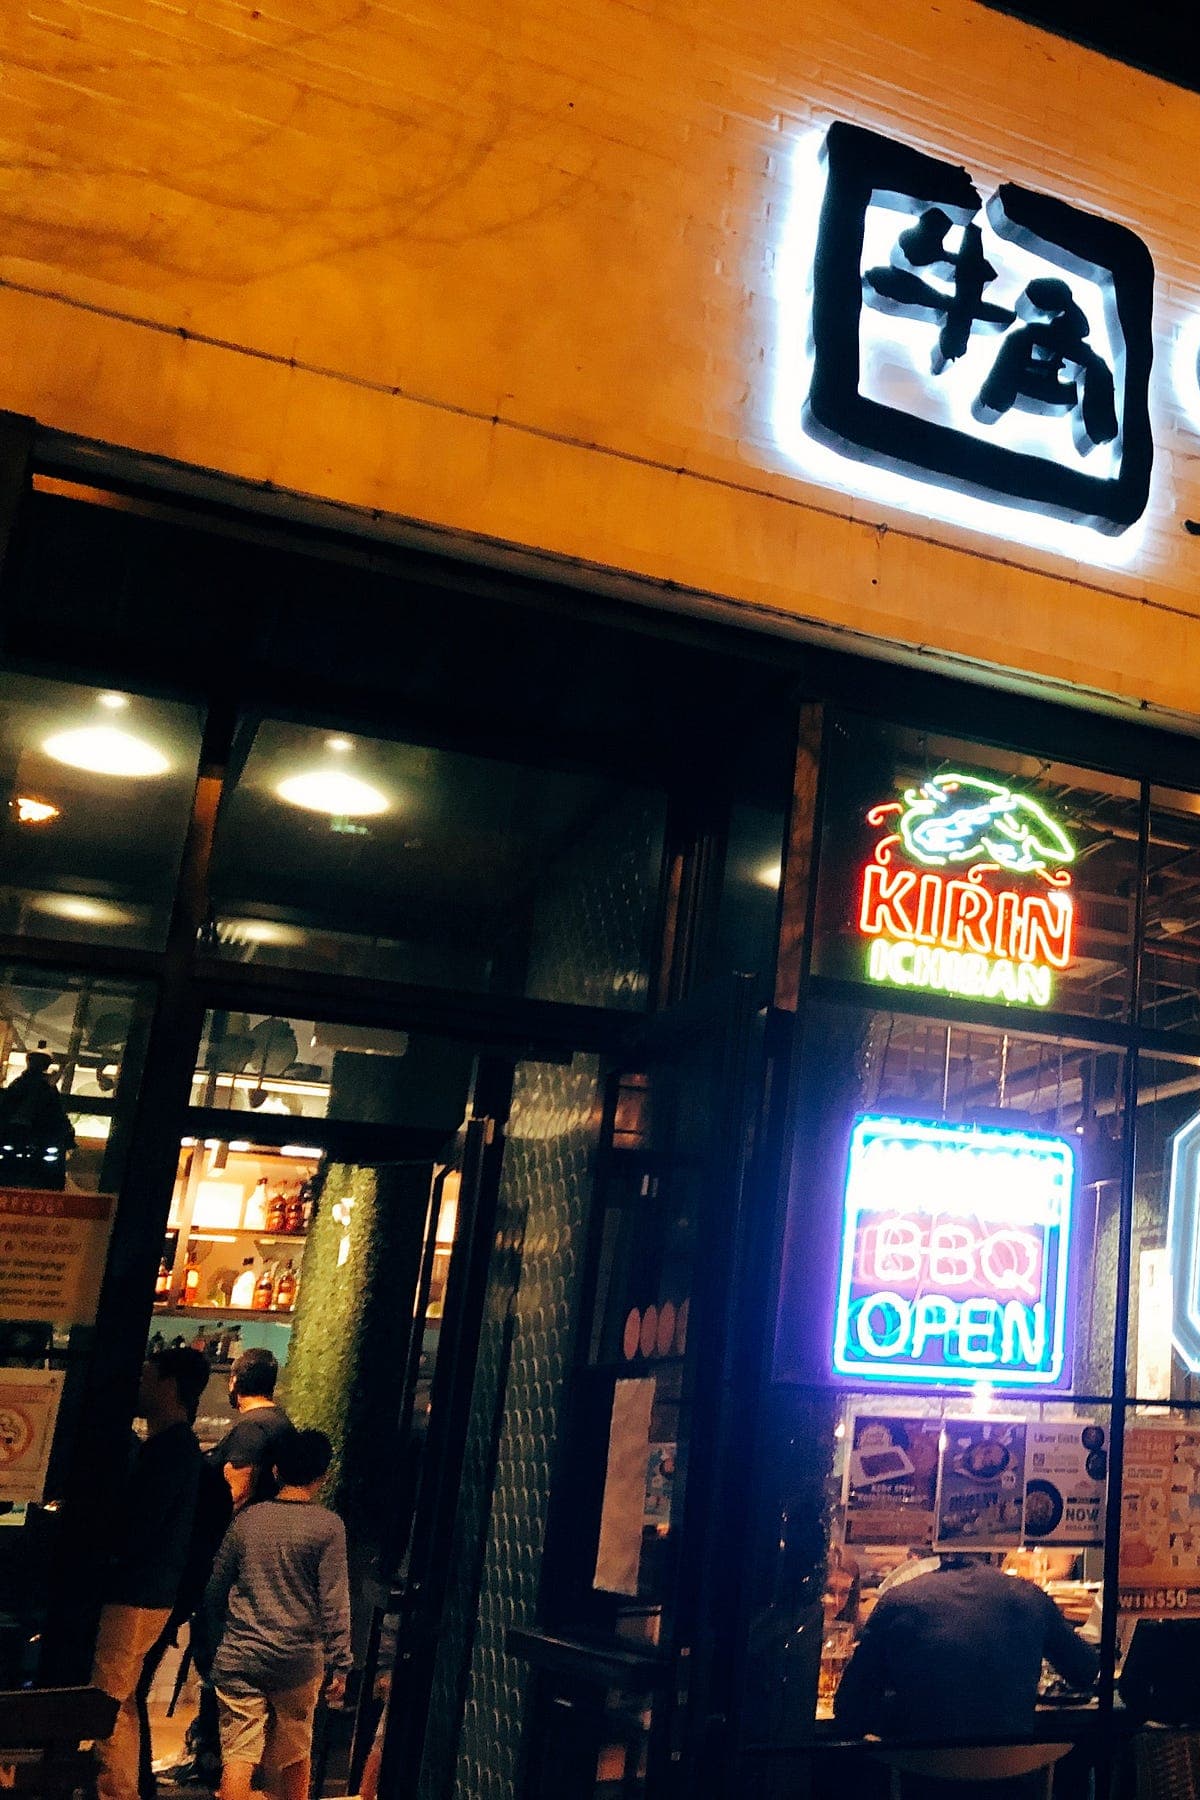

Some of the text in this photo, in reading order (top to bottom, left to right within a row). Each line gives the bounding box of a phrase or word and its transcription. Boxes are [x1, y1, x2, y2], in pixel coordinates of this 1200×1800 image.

[860, 864, 1073, 968] KIRIN
[873, 1218, 1038, 1296] BBQ
[856, 1290, 1046, 1366] OPEN
[1065, 1507, 1100, 1523] NOW
